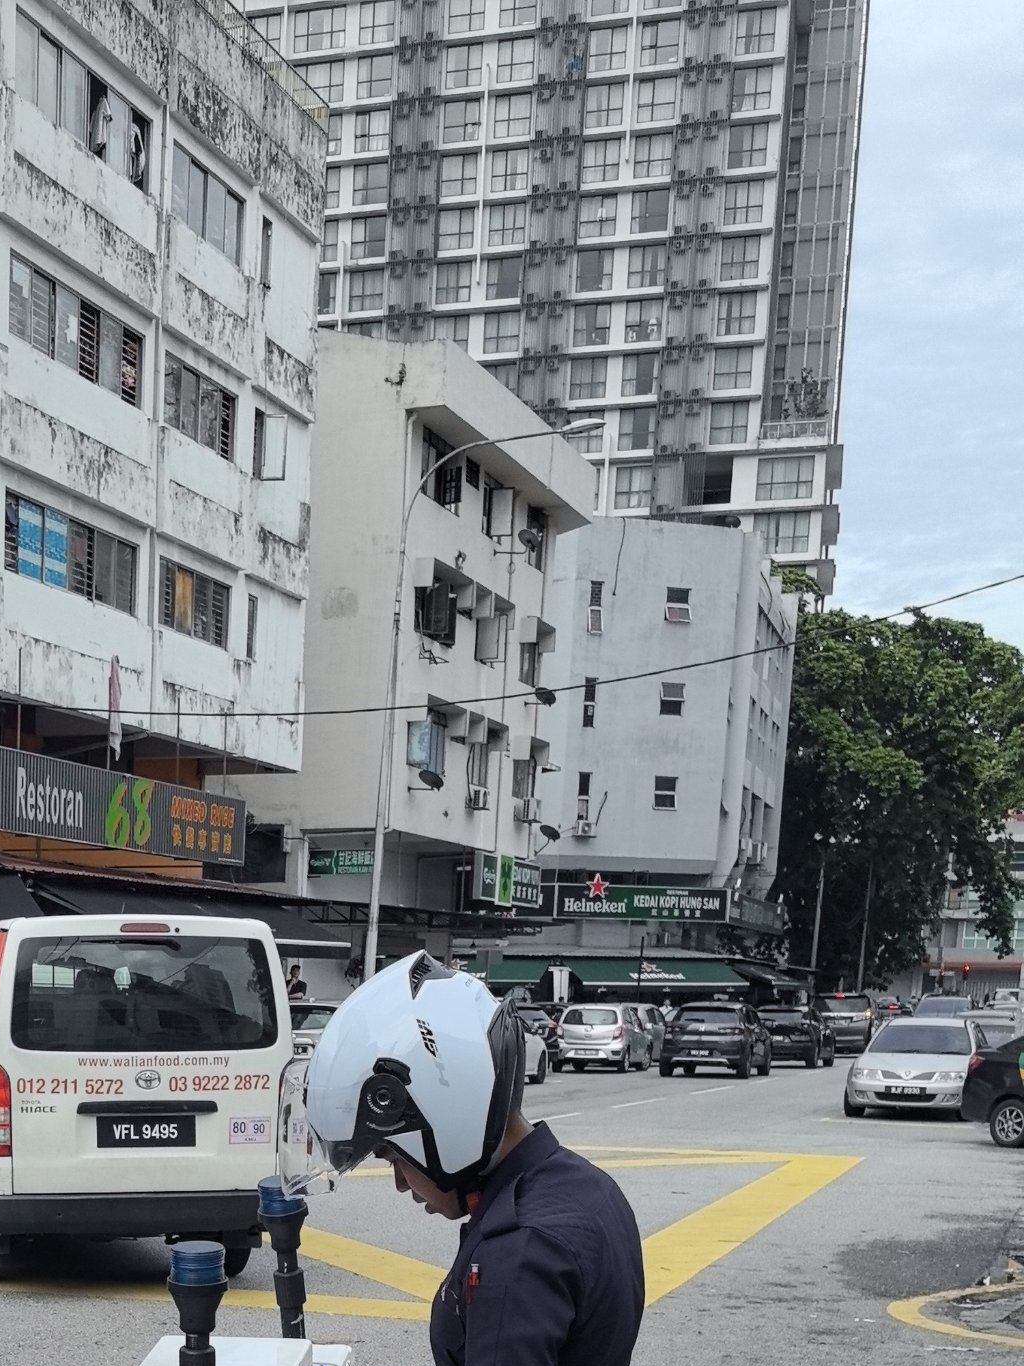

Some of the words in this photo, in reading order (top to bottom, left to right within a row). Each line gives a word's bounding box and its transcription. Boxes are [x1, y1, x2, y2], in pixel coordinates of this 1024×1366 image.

[16, 766, 83, 829] Restoran
[105, 778, 153, 848] 68
[171, 795, 207, 823] MIXED
[210, 803, 235, 829] RICE
[564, 897, 626, 913] Heineken
[633, 894, 659, 908] KEDAI
[659, 896, 679, 909] KOPI
[679, 896, 703, 910] HUNG
[702, 897, 720, 910] SAN
[77, 1055, 230, 1068] www.walianfood.com.my
[16, 1078, 46, 1094] 012
[50, 1078, 78, 1095] 211
[84, 1079, 124, 1095] 5272
[169, 1076, 188, 1092] 03
[192, 1075, 229, 1092] 9222
[234, 1074, 270, 1091] 2872
[113, 1124, 140, 1140] VFL
[142, 1123, 178, 1139] 9495
[232, 1121, 246, 1134] 80
[253, 1123, 265, 1134] 90
